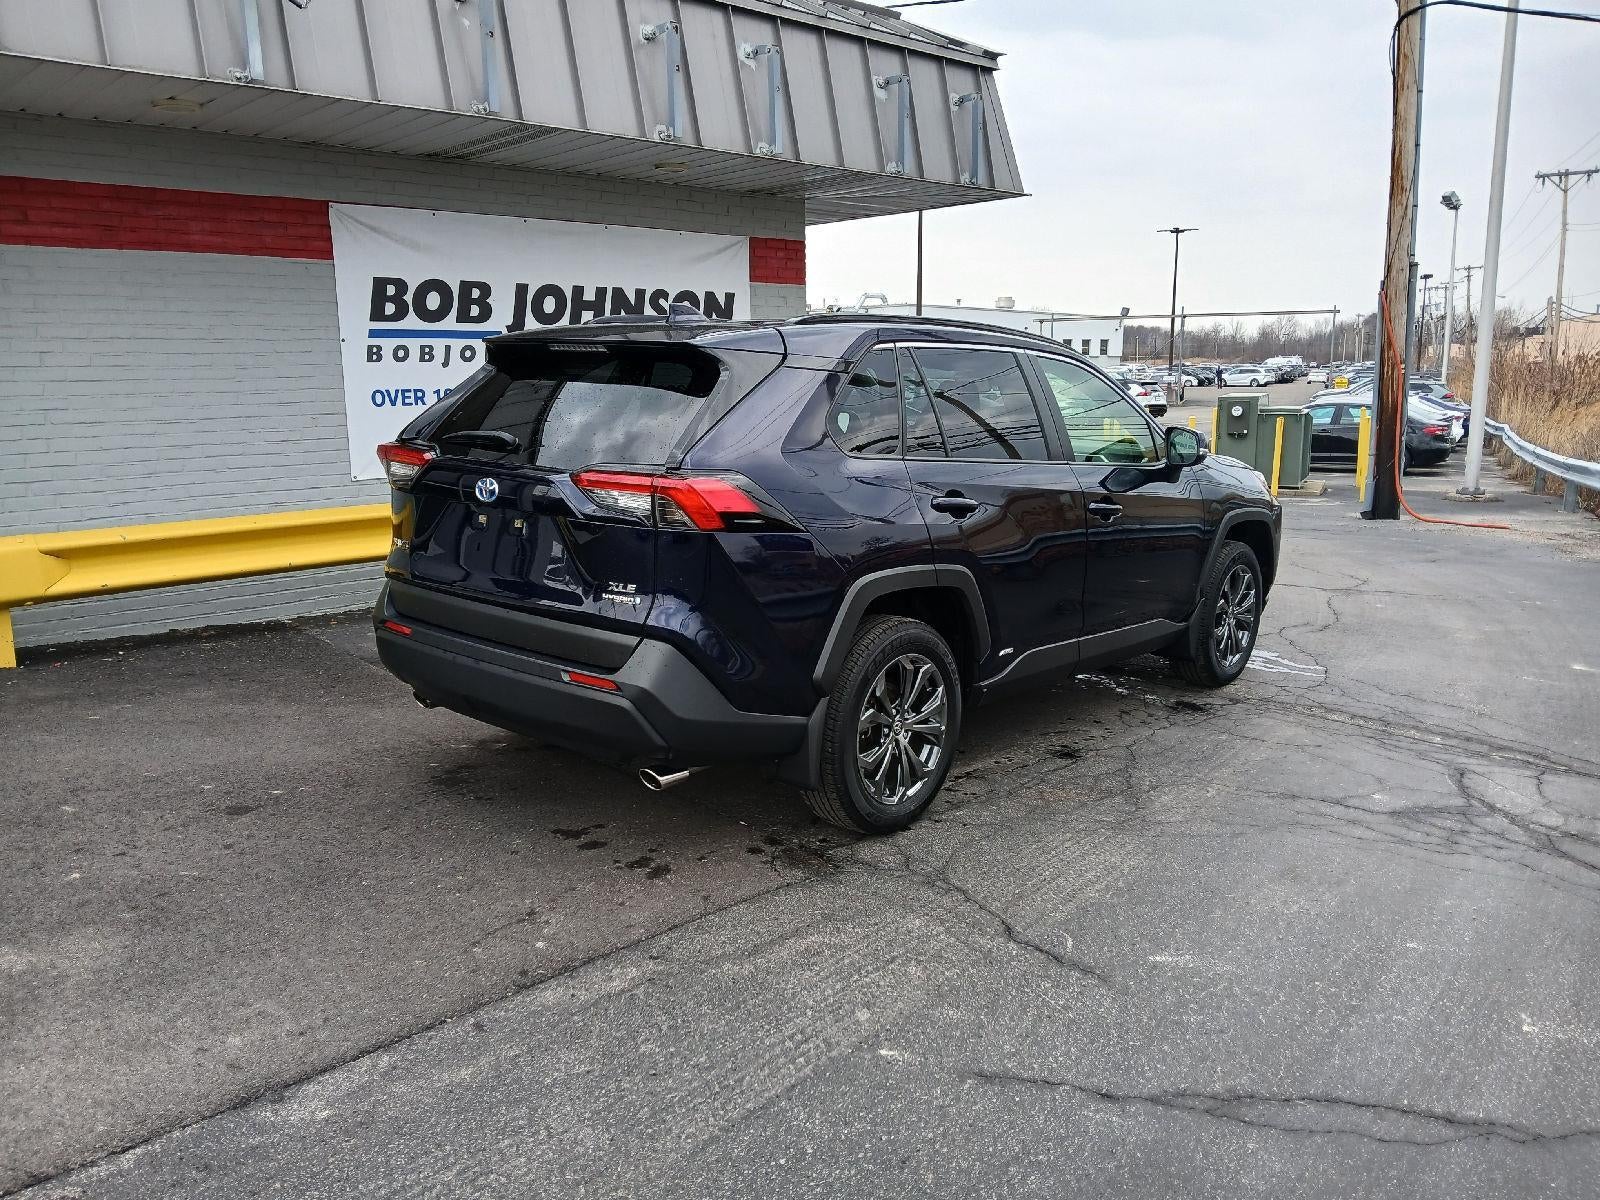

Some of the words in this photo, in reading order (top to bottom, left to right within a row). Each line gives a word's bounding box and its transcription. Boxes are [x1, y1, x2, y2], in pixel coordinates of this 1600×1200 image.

[369, 276, 493, 324] BOB
[505, 282, 736, 333] JOHNSON
[366, 344, 488, 369] BOBJO
[371, 388, 427, 408] OVER
[606, 581, 637, 593] XLE
